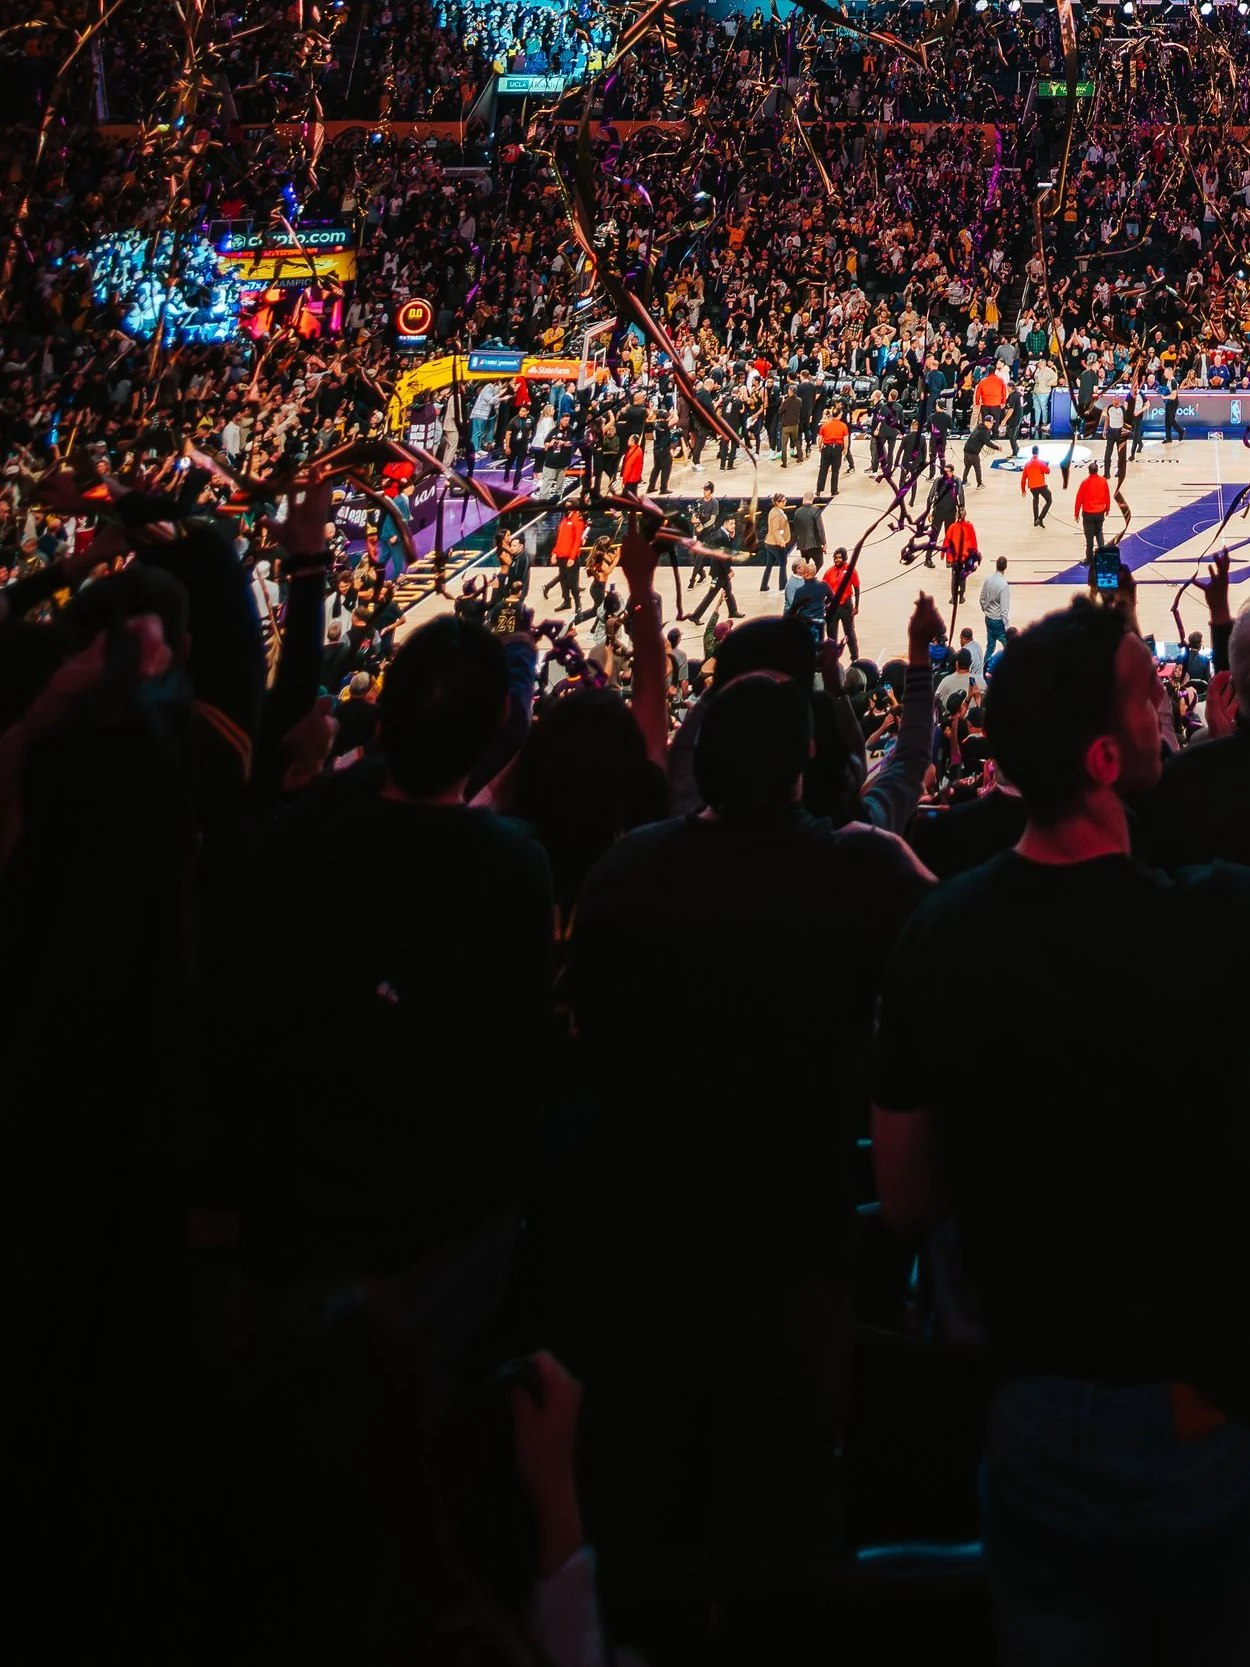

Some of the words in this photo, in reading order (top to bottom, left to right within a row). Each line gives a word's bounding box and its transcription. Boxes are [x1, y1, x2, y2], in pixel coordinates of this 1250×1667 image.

[509, 81, 527, 89] UCLA
[1152, 404, 1196, 420] peock
[497, 615, 516, 633] 24
